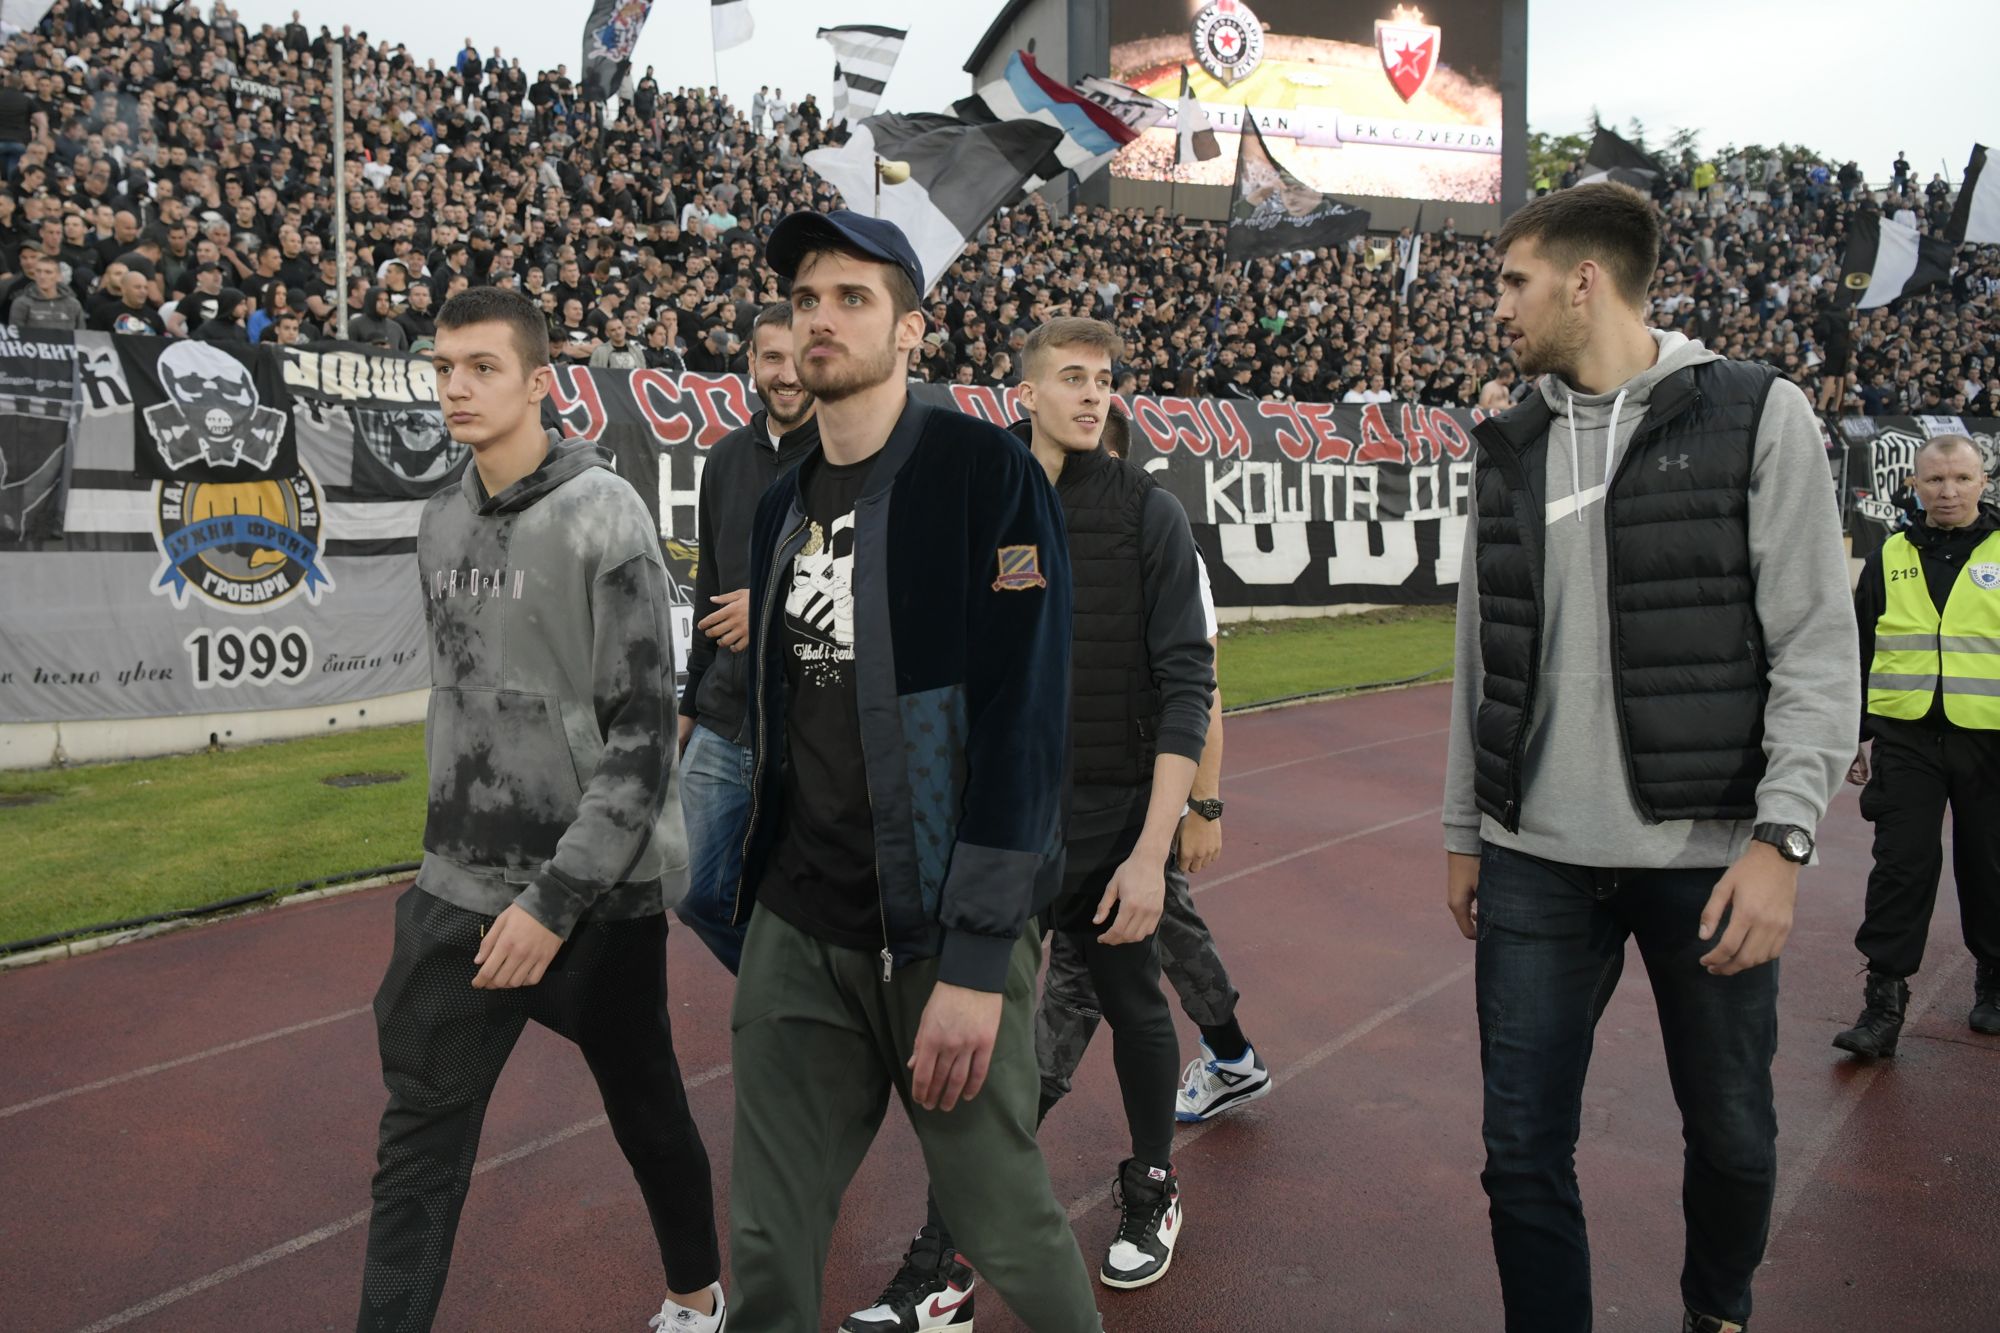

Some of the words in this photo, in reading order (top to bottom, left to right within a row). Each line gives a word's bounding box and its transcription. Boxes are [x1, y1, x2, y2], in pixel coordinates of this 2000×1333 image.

[1355, 123, 1379, 137] FK
[1205, 459, 1379, 525] КОШТА
[202, 572, 290, 602] ГРОБАРИ
[1890, 567, 1918, 581] 219
[190, 631, 309, 683] 1999
